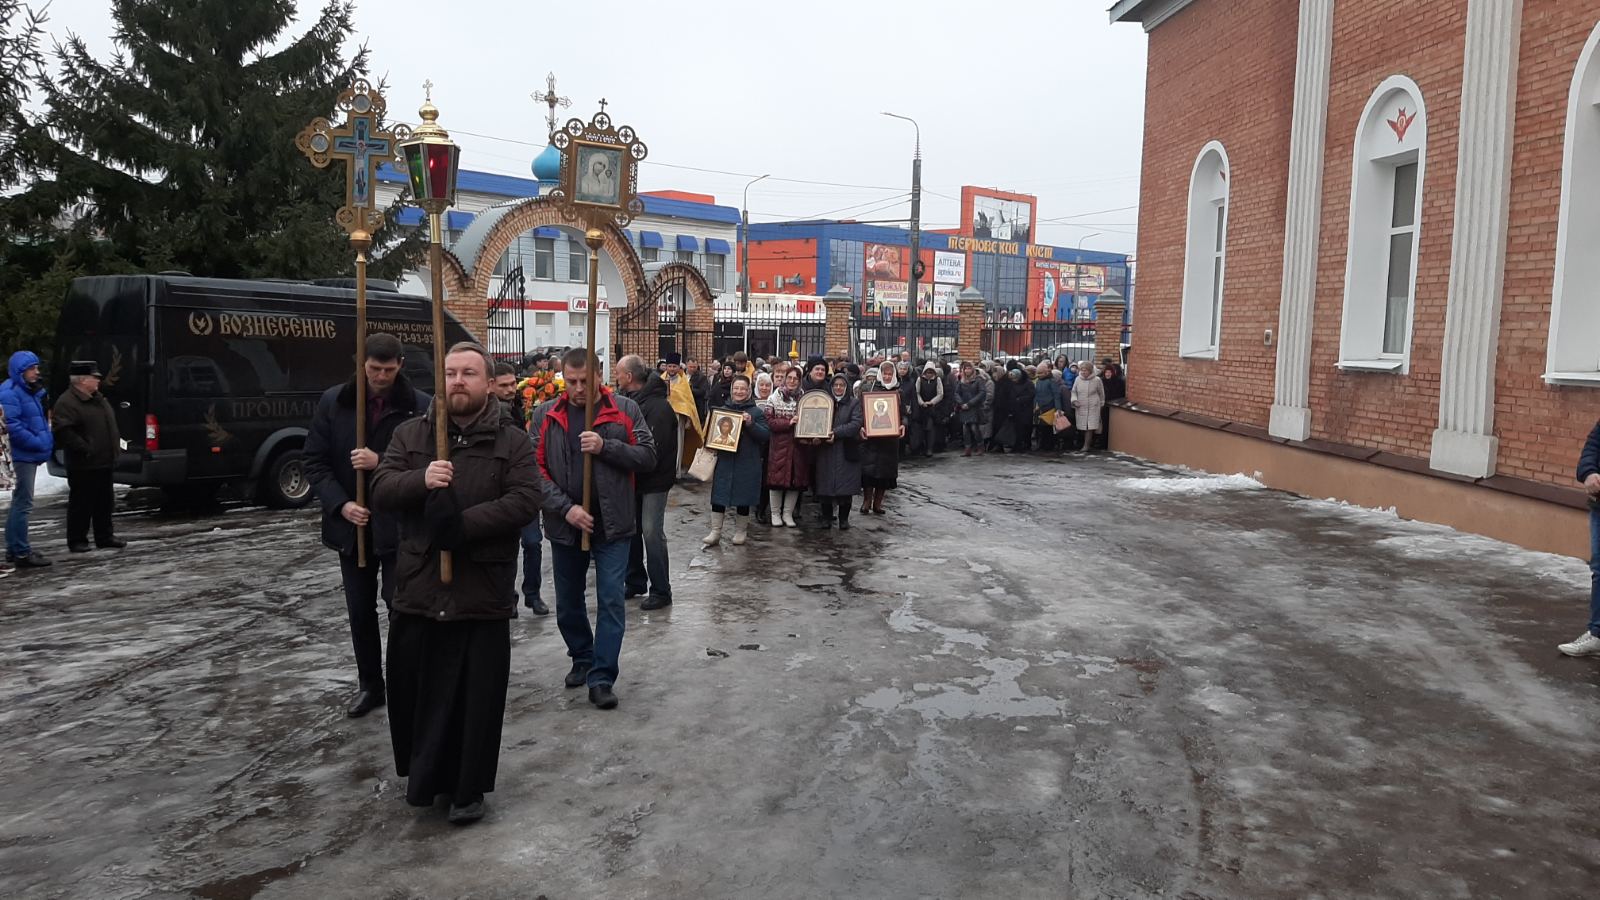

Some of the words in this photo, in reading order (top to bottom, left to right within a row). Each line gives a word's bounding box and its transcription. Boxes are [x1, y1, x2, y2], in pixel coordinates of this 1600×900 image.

[1026, 244, 1053, 258] КУСТ
[938, 259, 961, 267] АПТЕКА
[219, 313, 337, 339] ВОЗНЕСЕНИЕ
